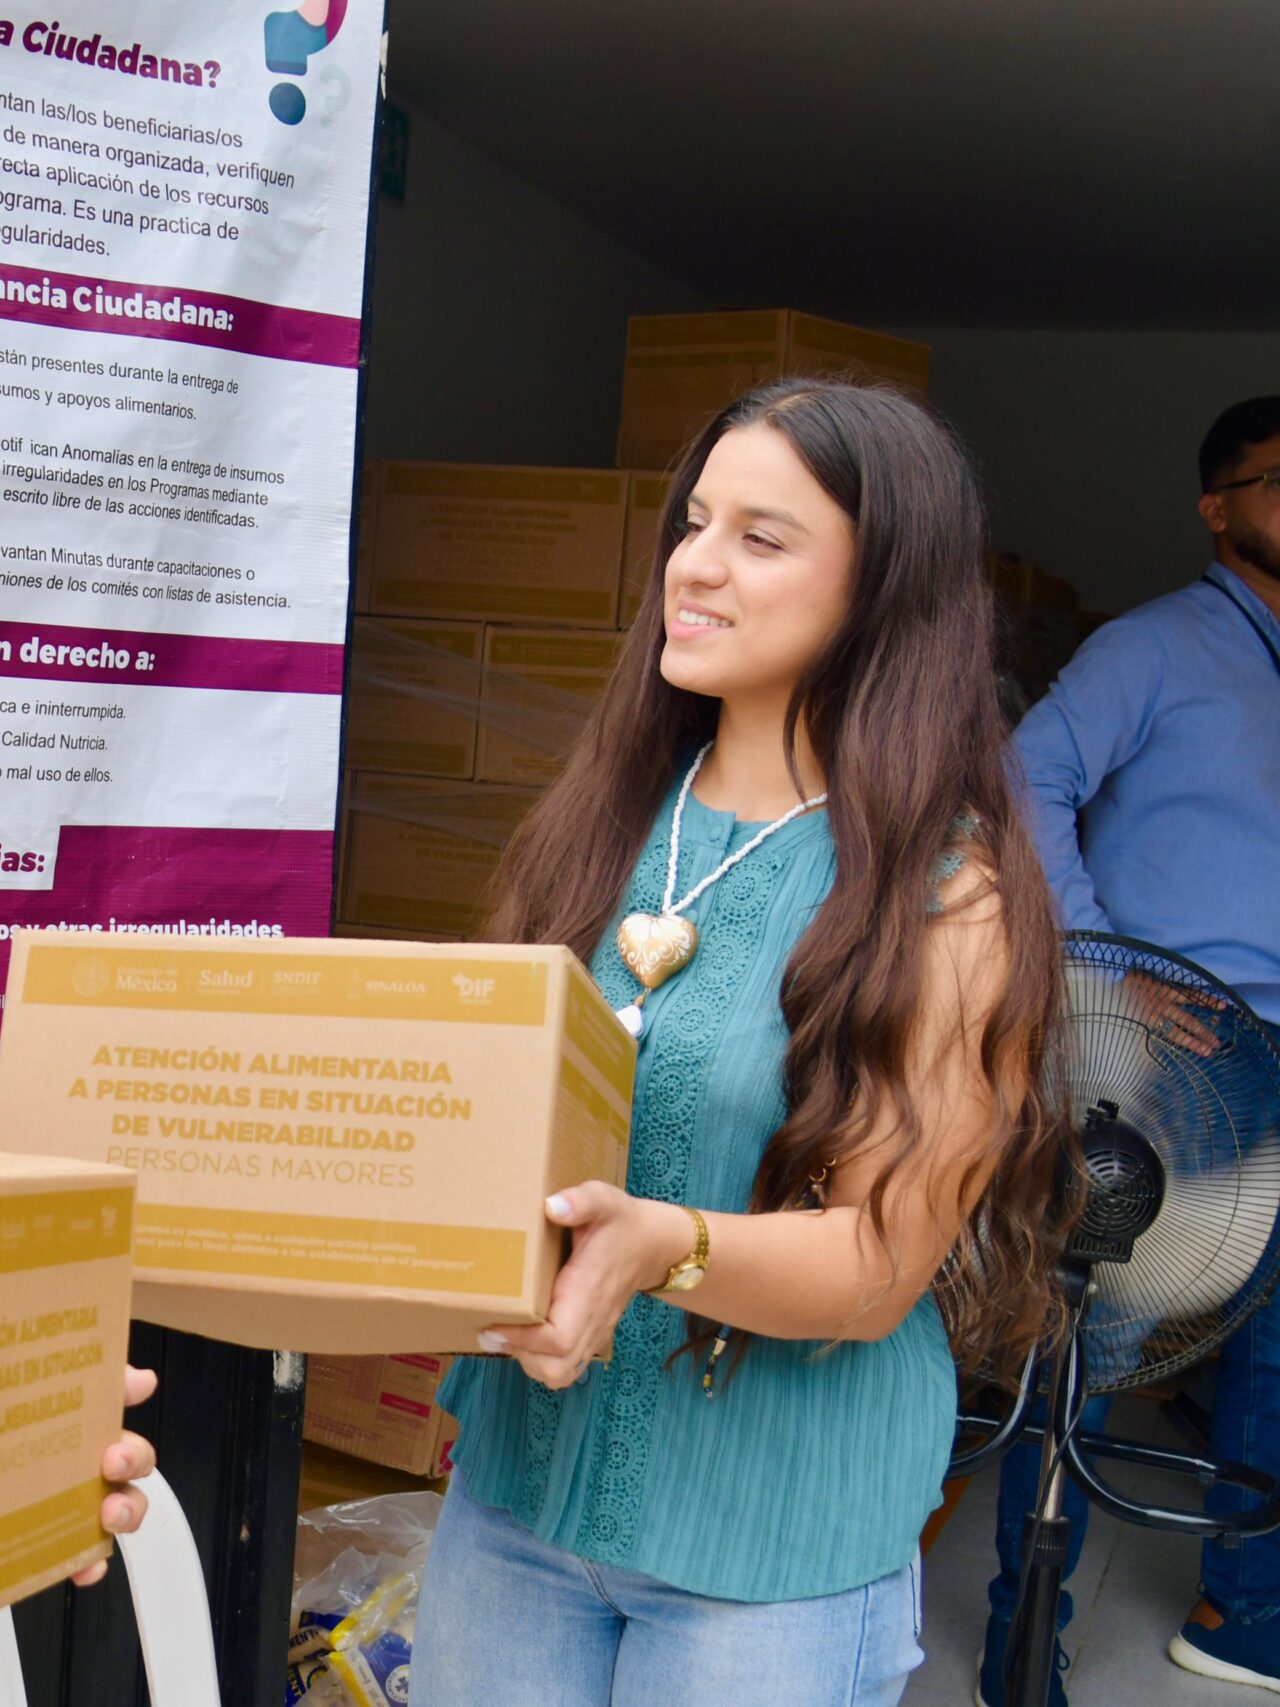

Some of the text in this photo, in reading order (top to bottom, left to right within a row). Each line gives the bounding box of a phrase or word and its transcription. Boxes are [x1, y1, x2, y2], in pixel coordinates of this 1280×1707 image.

[22, 20, 221, 88] Ciudadana?
[3, 124, 26, 145] de
[32, 133, 100, 158] manera
[105, 146, 210, 177] organizada,
[216, 162, 295, 189] verifiquen
[73, 198, 96, 221] Es
[102, 208, 134, 228] una
[139, 215, 211, 237] practica
[216, 221, 239, 241] de
[72, 285, 234, 331] Ciudadana:
[31, 356, 105, 376] presentes
[108, 362, 164, 383] durante
[167, 368, 179, 385] la
[181, 374, 225, 395] entrega
[226, 378, 239, 395] de
[51, 547, 103, 567] Minutas
[106, 553, 155, 573] durante
[156, 561, 242, 580] capacitaciones
[245, 569, 256, 581] o
[19, 636, 130, 669] derecho
[134, 651, 155, 671] a:
[21, 702, 31, 715] e
[35, 702, 127, 722] ininterrumpida.
[6, 765, 32, 780] mal
[36, 769, 62, 782] uso
[65, 767, 81, 782] de
[83, 767, 113, 783] ellos.
[198, 968, 254, 988] Salud
[458, 977, 495, 998] DIF
[91, 1044, 453, 1084] ATENCIÓN ALIMENTARIA
[67, 1077, 472, 1121] A PERSONAS EN SITUACIÓN
[111, 1113, 416, 1153] DE VULNERABILIDAD
[106, 1144, 415, 1188] PERSONAS MAYORES
